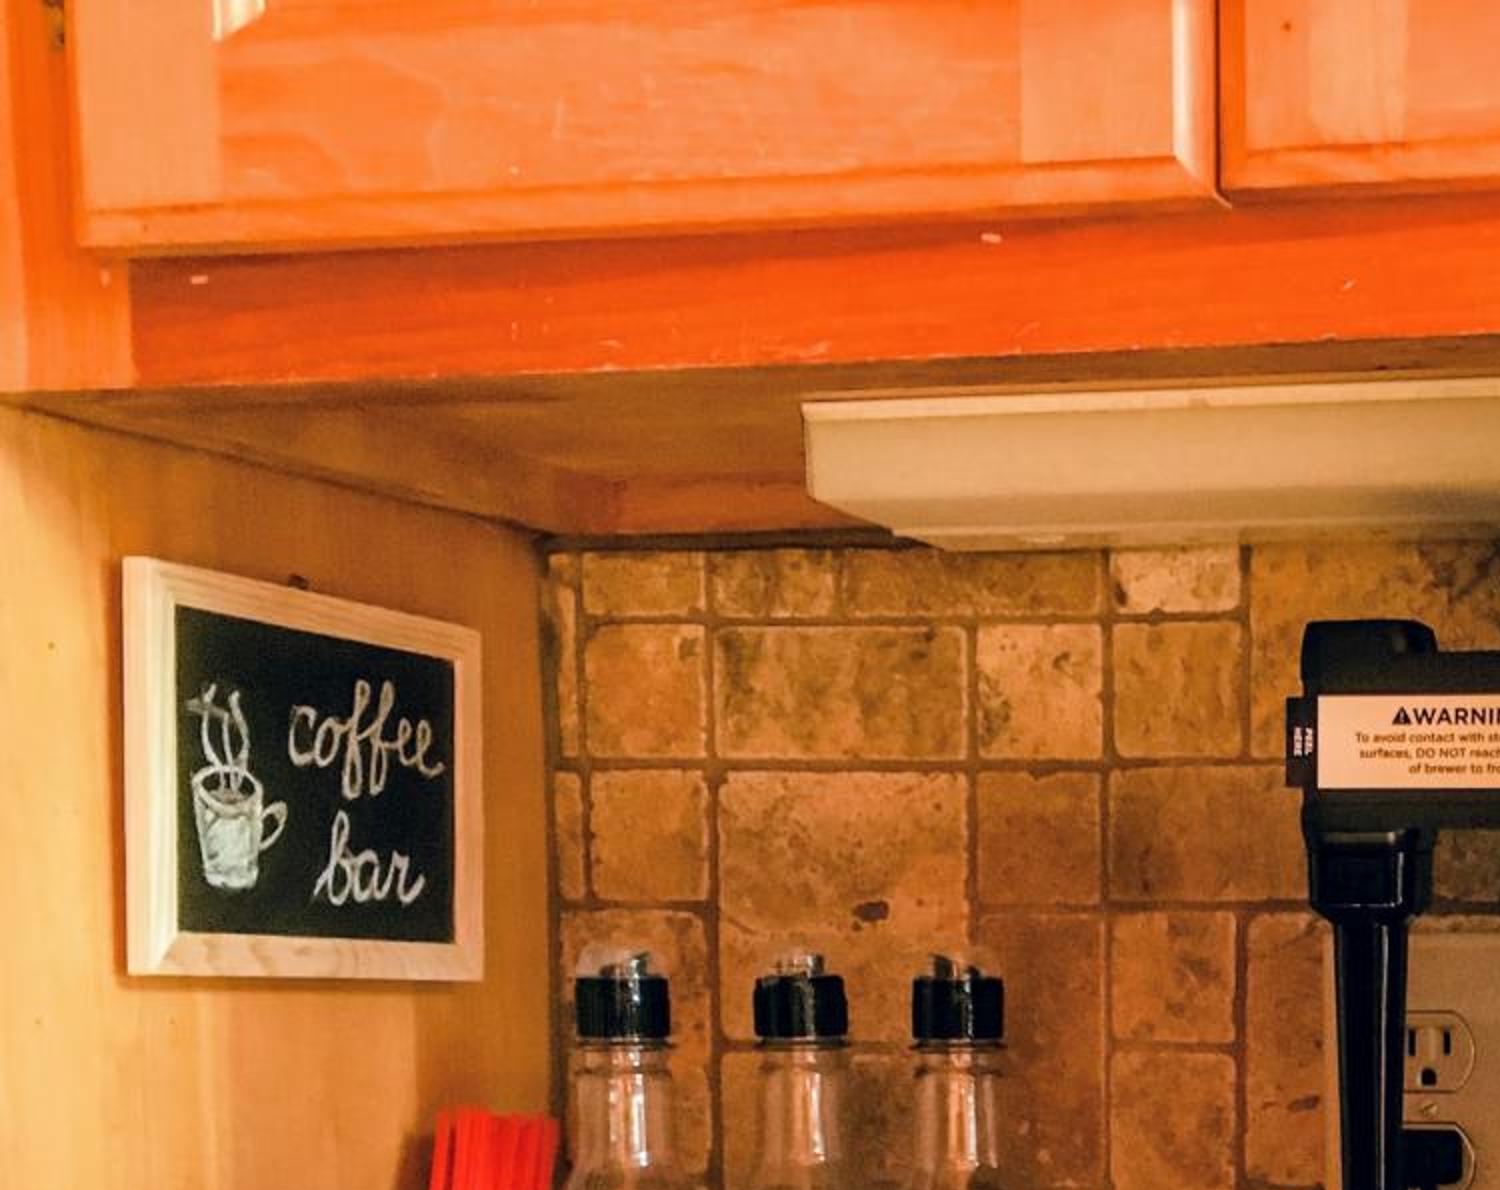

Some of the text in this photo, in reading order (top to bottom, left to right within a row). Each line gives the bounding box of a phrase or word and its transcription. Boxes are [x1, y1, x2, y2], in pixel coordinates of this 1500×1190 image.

[289, 679, 446, 800] coffee
[1355, 733, 1370, 743] To
[1373, 732, 1405, 743] avoid
[1409, 732, 1455, 743] contact
[1459, 732, 1484, 743] with
[1416, 748, 1435, 759] DO
[1439, 748, 1466, 759] NOT
[1409, 763, 1422, 774] of
[1424, 763, 1467, 774] brewer
[1470, 764, 1483, 774] to
[314, 810, 426, 907] bar
